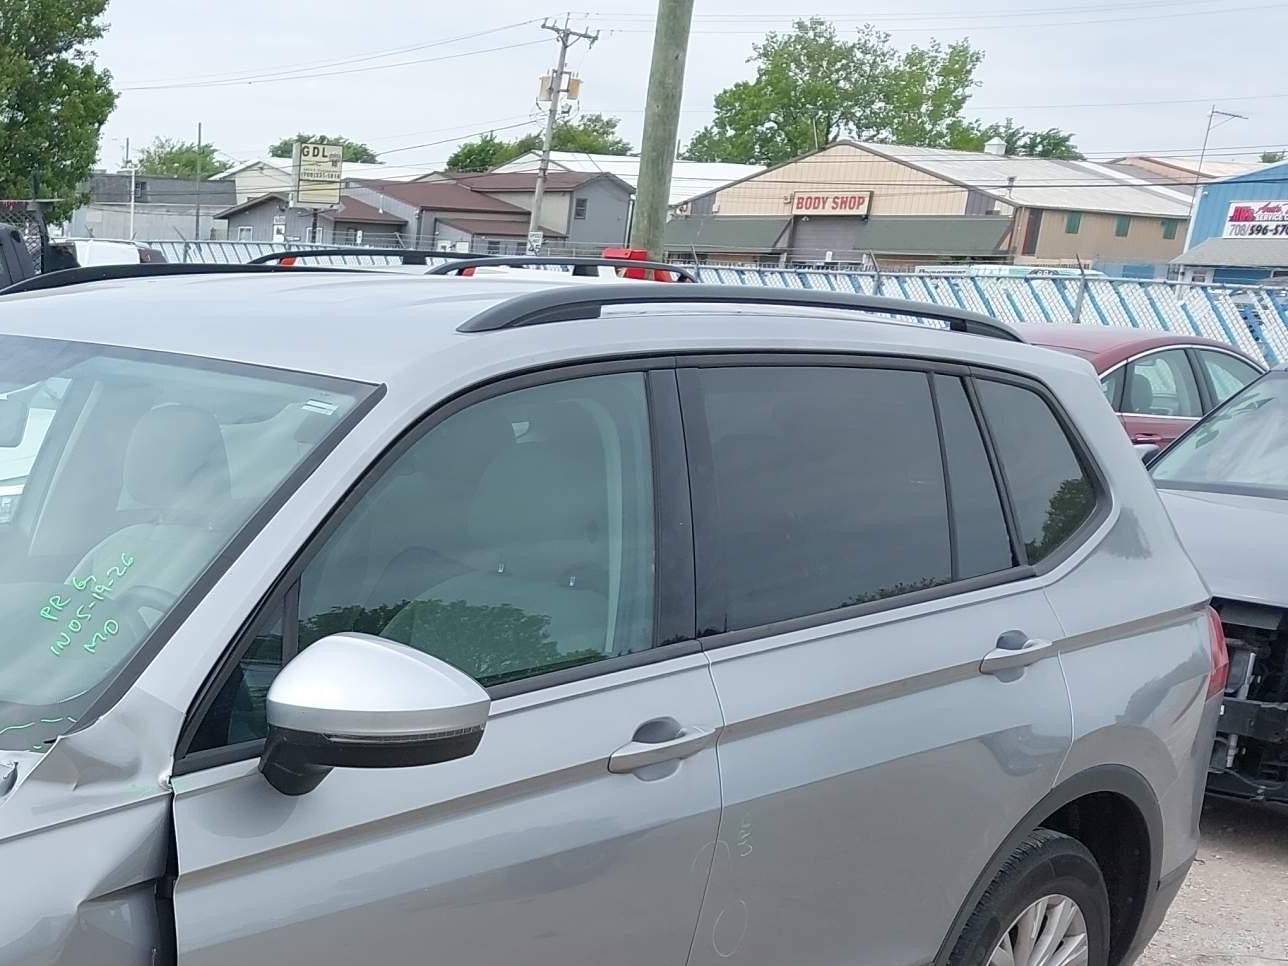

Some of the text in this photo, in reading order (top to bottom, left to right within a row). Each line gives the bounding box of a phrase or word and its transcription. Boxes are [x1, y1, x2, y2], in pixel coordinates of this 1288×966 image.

[302, 146, 328, 158] GDL
[796, 196, 866, 210] BODY SHOP
[40, 595, 71, 620] PR
